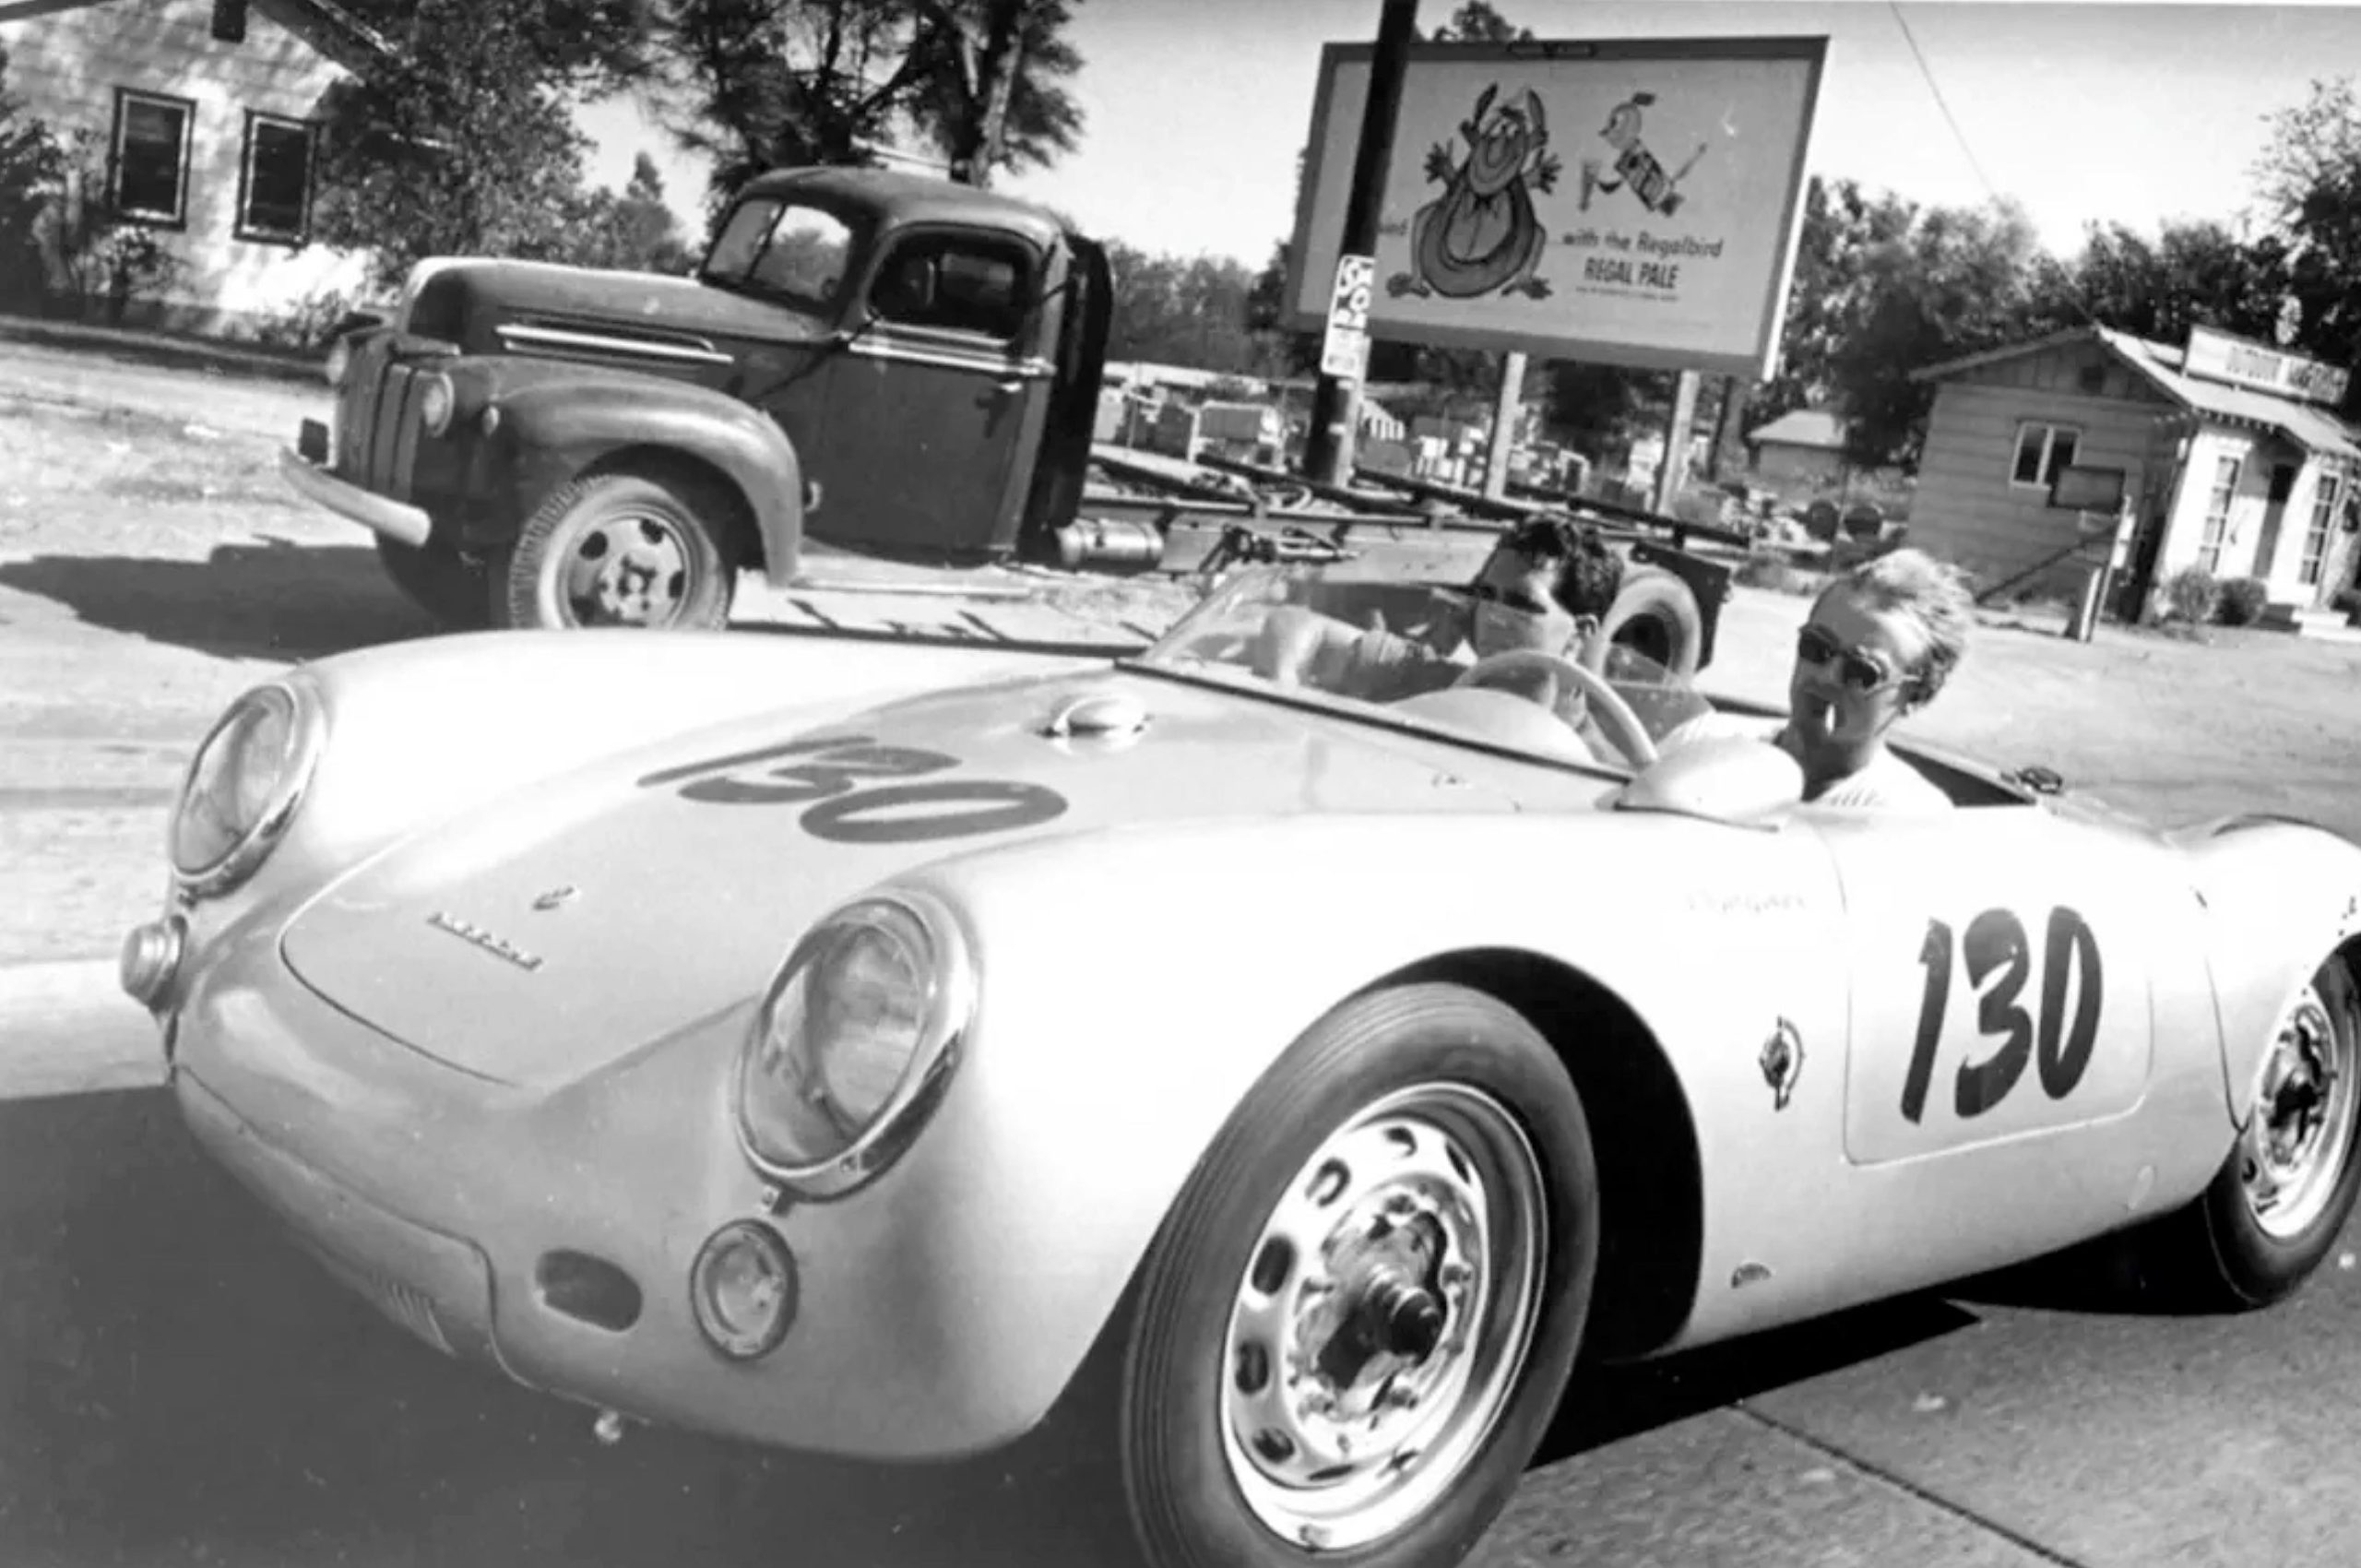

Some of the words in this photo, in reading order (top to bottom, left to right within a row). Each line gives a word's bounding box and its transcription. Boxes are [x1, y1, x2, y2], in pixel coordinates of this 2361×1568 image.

[1562, 227, 1599, 248] with
[1605, 230, 1631, 251] the
[1636, 230, 1724, 259] Regalbird
[1584, 256, 1632, 285] REGAL
[1638, 261, 1679, 290] PALE
[1901, 905, 2103, 1125] 130
